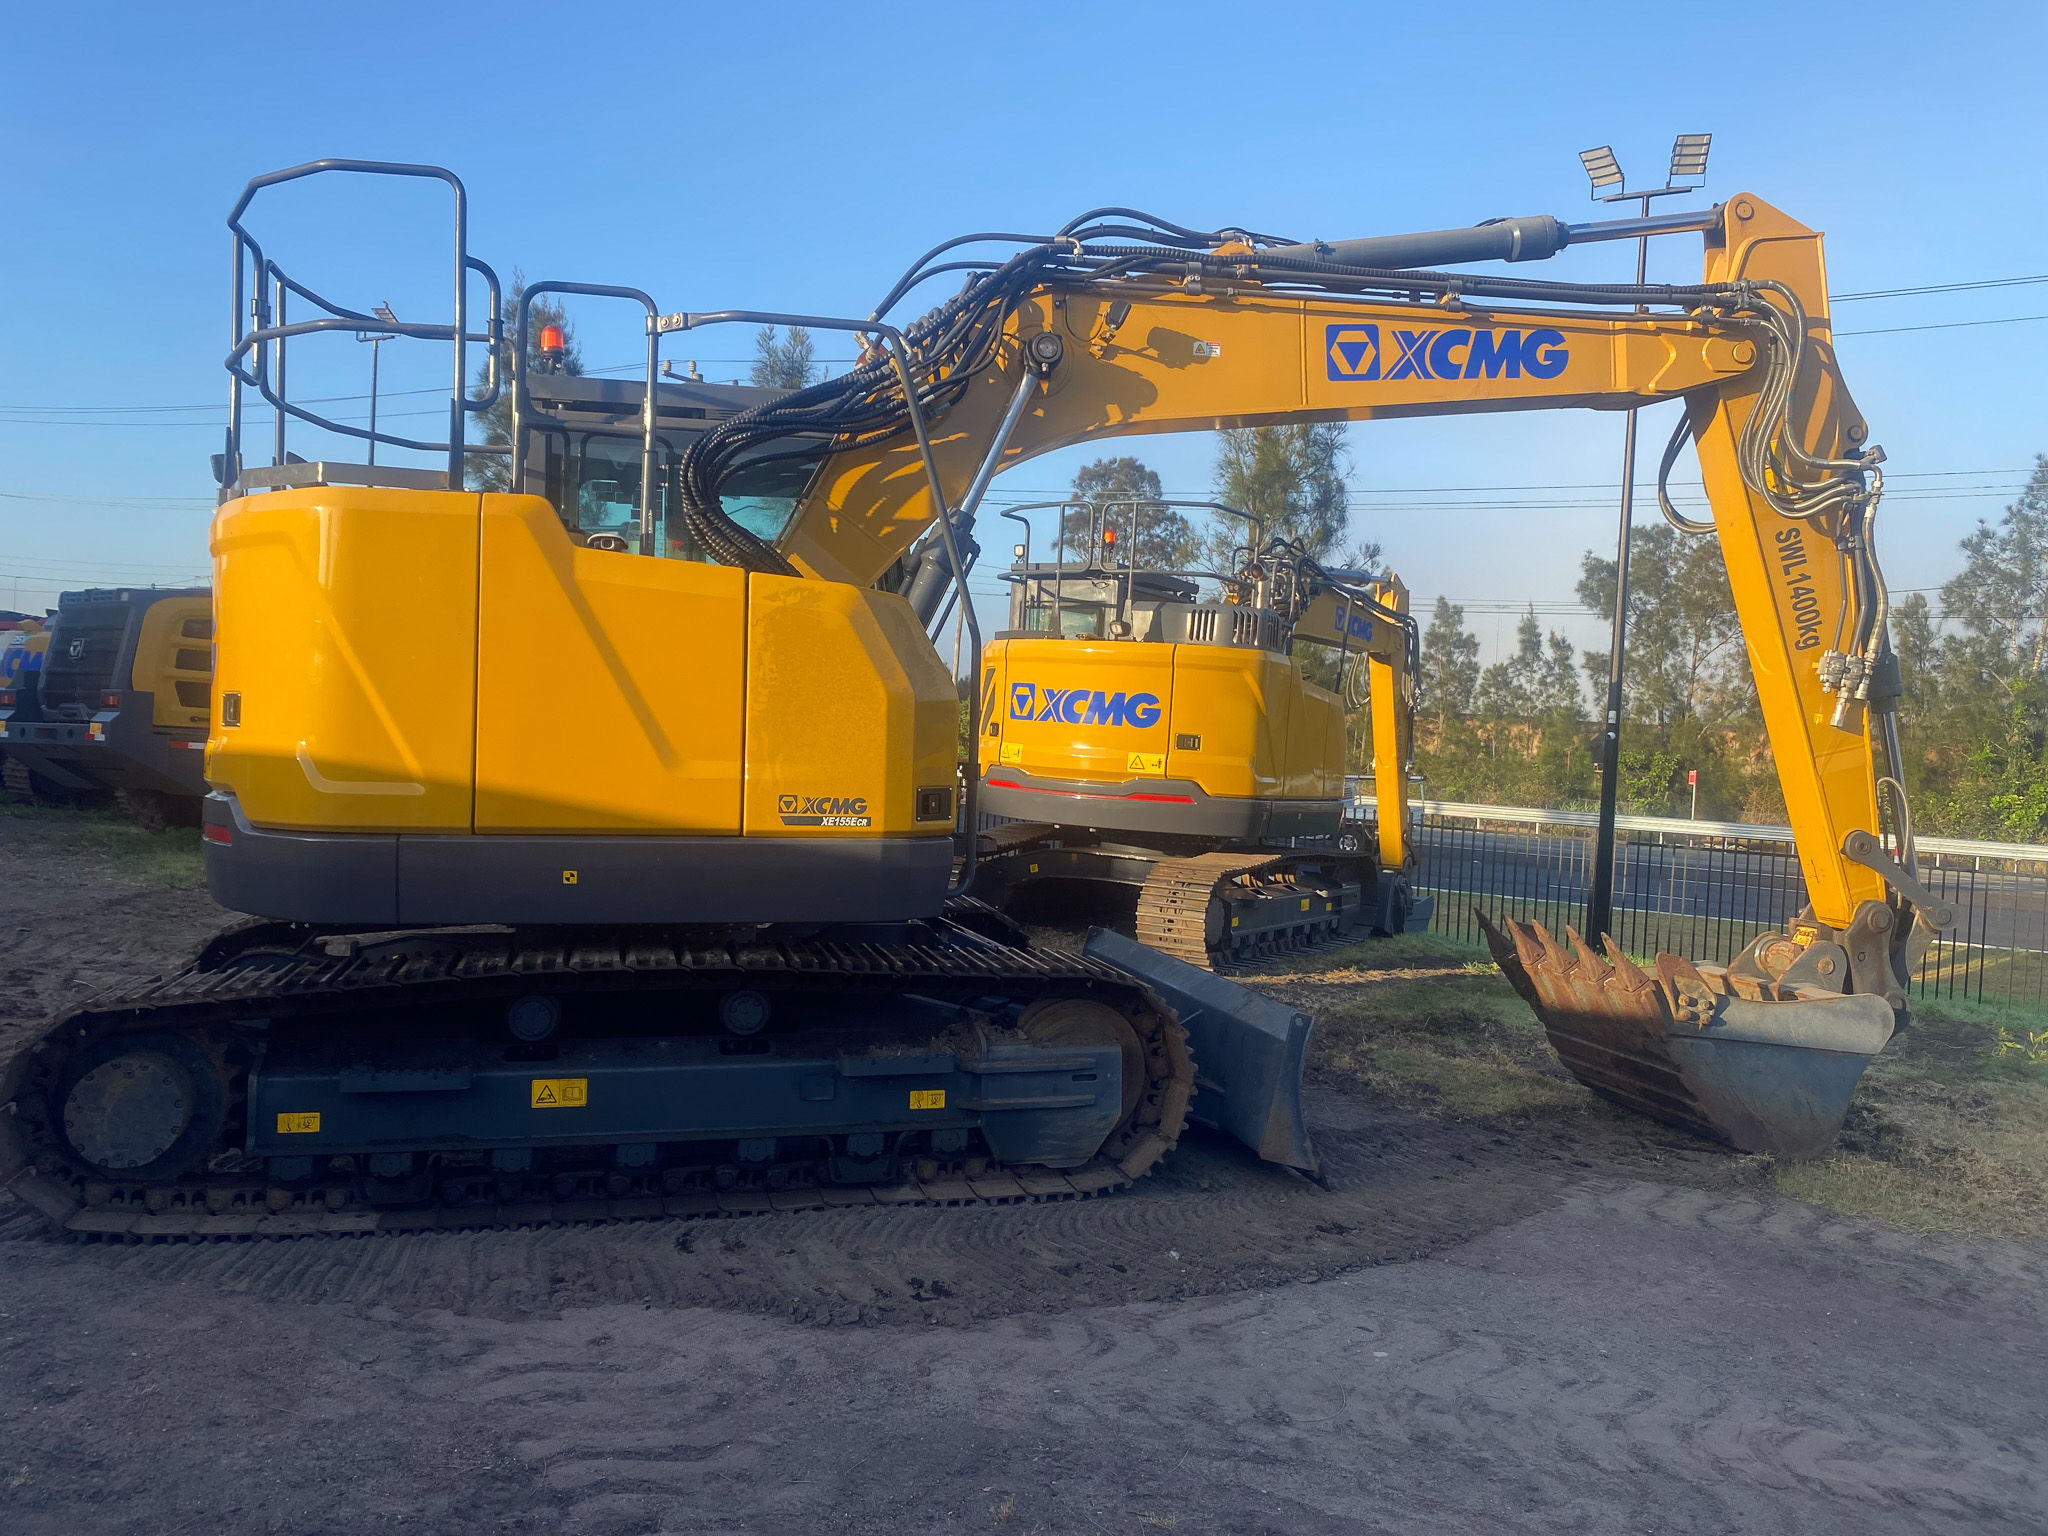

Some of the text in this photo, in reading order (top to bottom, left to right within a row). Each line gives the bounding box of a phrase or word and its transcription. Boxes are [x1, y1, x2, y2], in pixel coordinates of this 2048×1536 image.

[1381, 328, 1569, 381] XCMG
[1348, 613, 1373, 643] CMG
[1034, 688, 1162, 729] XCMG
[798, 797, 868, 815] XCMG
[821, 816, 868, 827] XE155ECR
